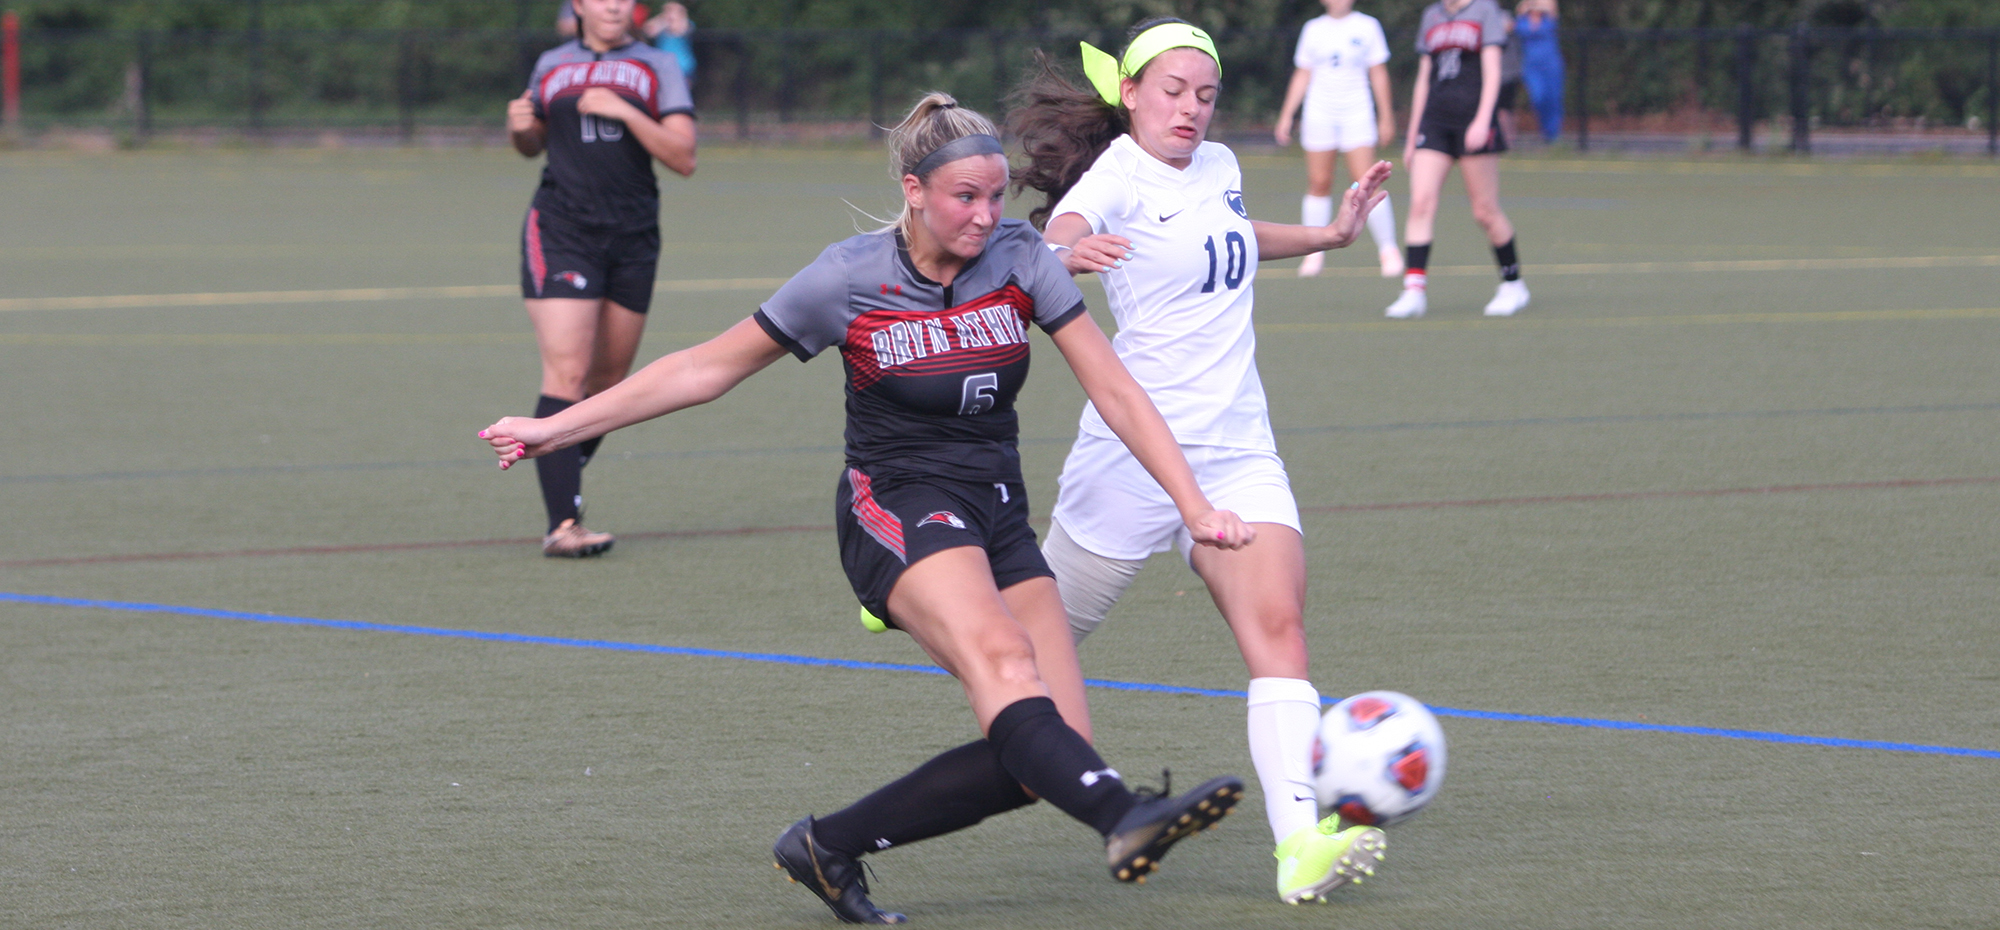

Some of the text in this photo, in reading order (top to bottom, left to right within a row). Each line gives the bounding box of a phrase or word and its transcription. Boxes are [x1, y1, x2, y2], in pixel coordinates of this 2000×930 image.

[1200, 230, 1247, 293] 10
[871, 317, 951, 369] BRYN
[957, 372, 998, 416] 6
